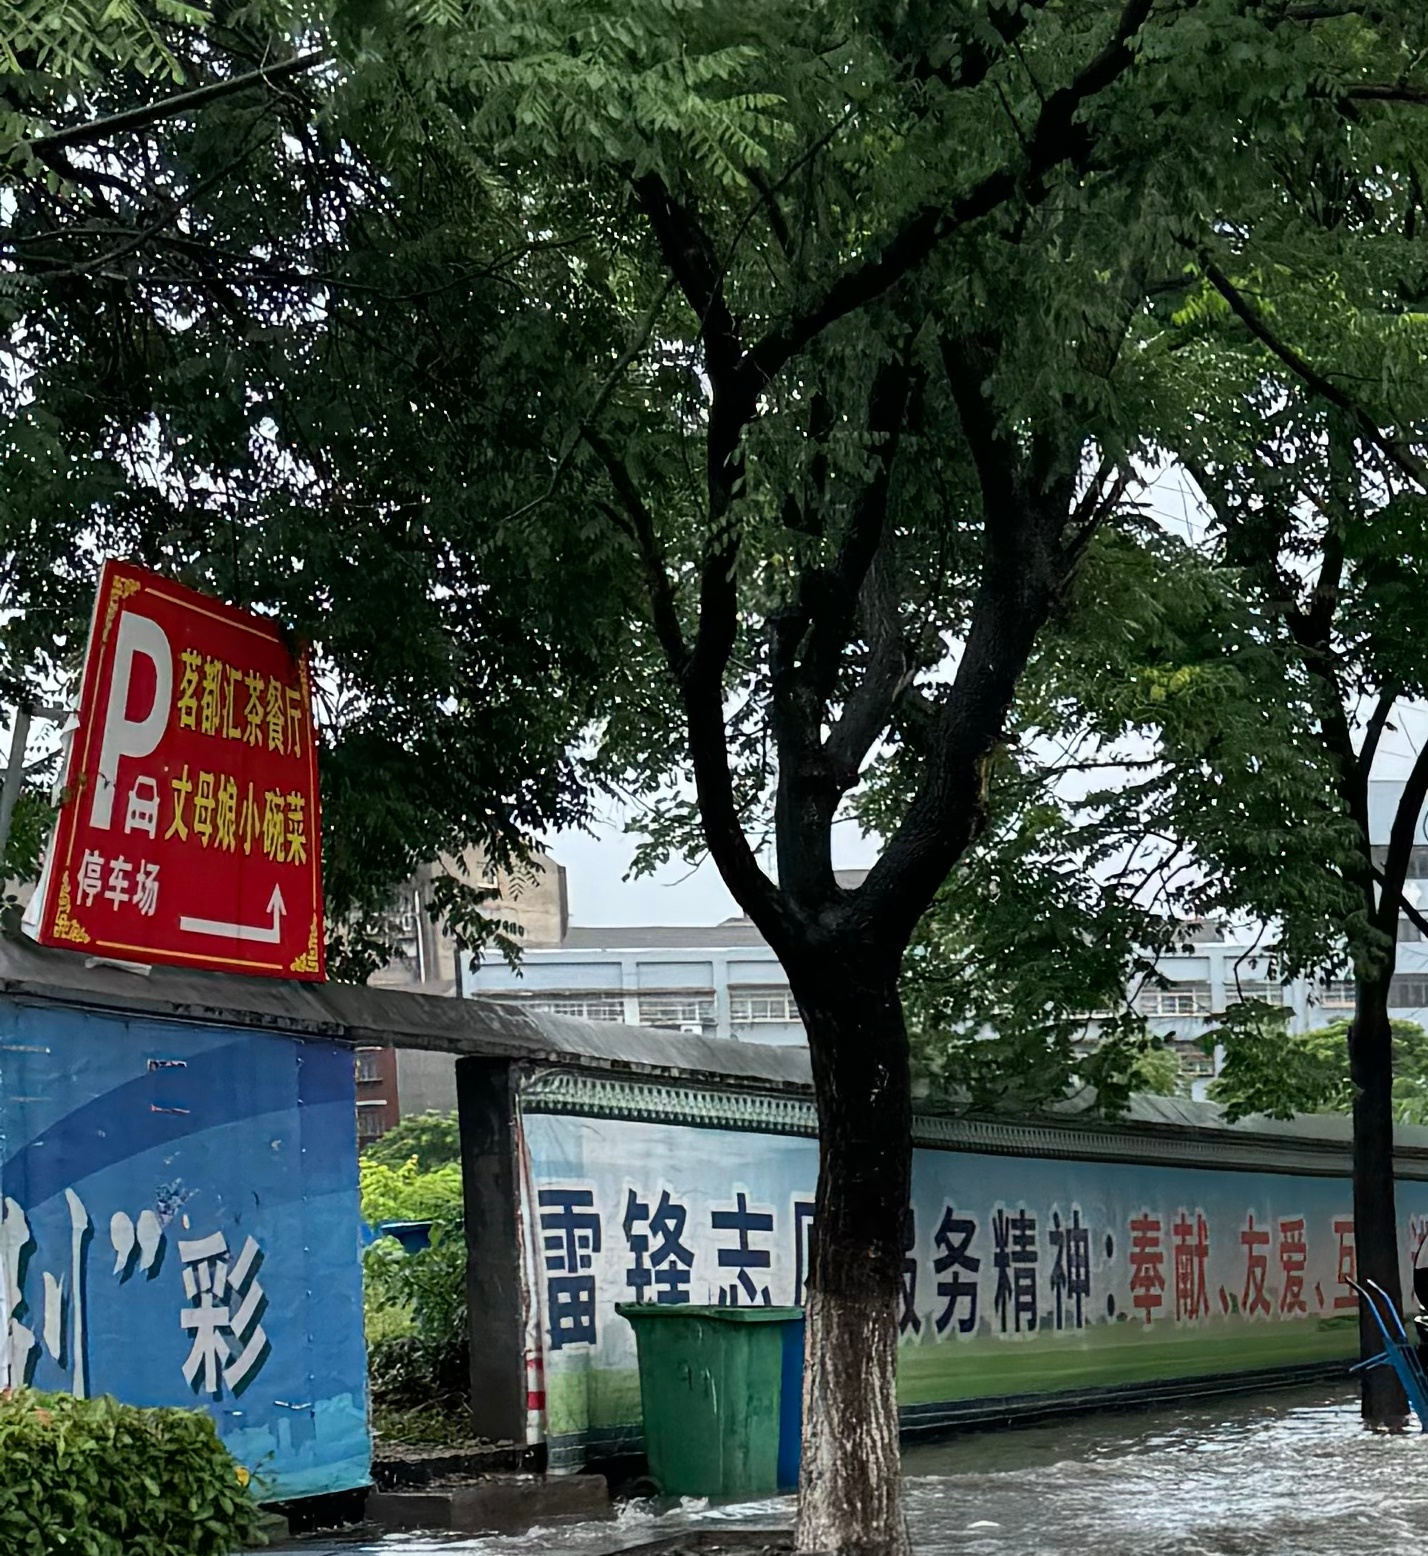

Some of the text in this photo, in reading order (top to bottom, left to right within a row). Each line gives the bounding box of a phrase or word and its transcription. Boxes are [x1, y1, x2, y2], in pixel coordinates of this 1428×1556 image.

[89, 609, 174, 830] P
[177, 647, 302, 759] 茗都汇茶餐厅
[164, 763, 307, 866] 丈母娘小碗菜
[76, 848, 160, 917] 停车场
